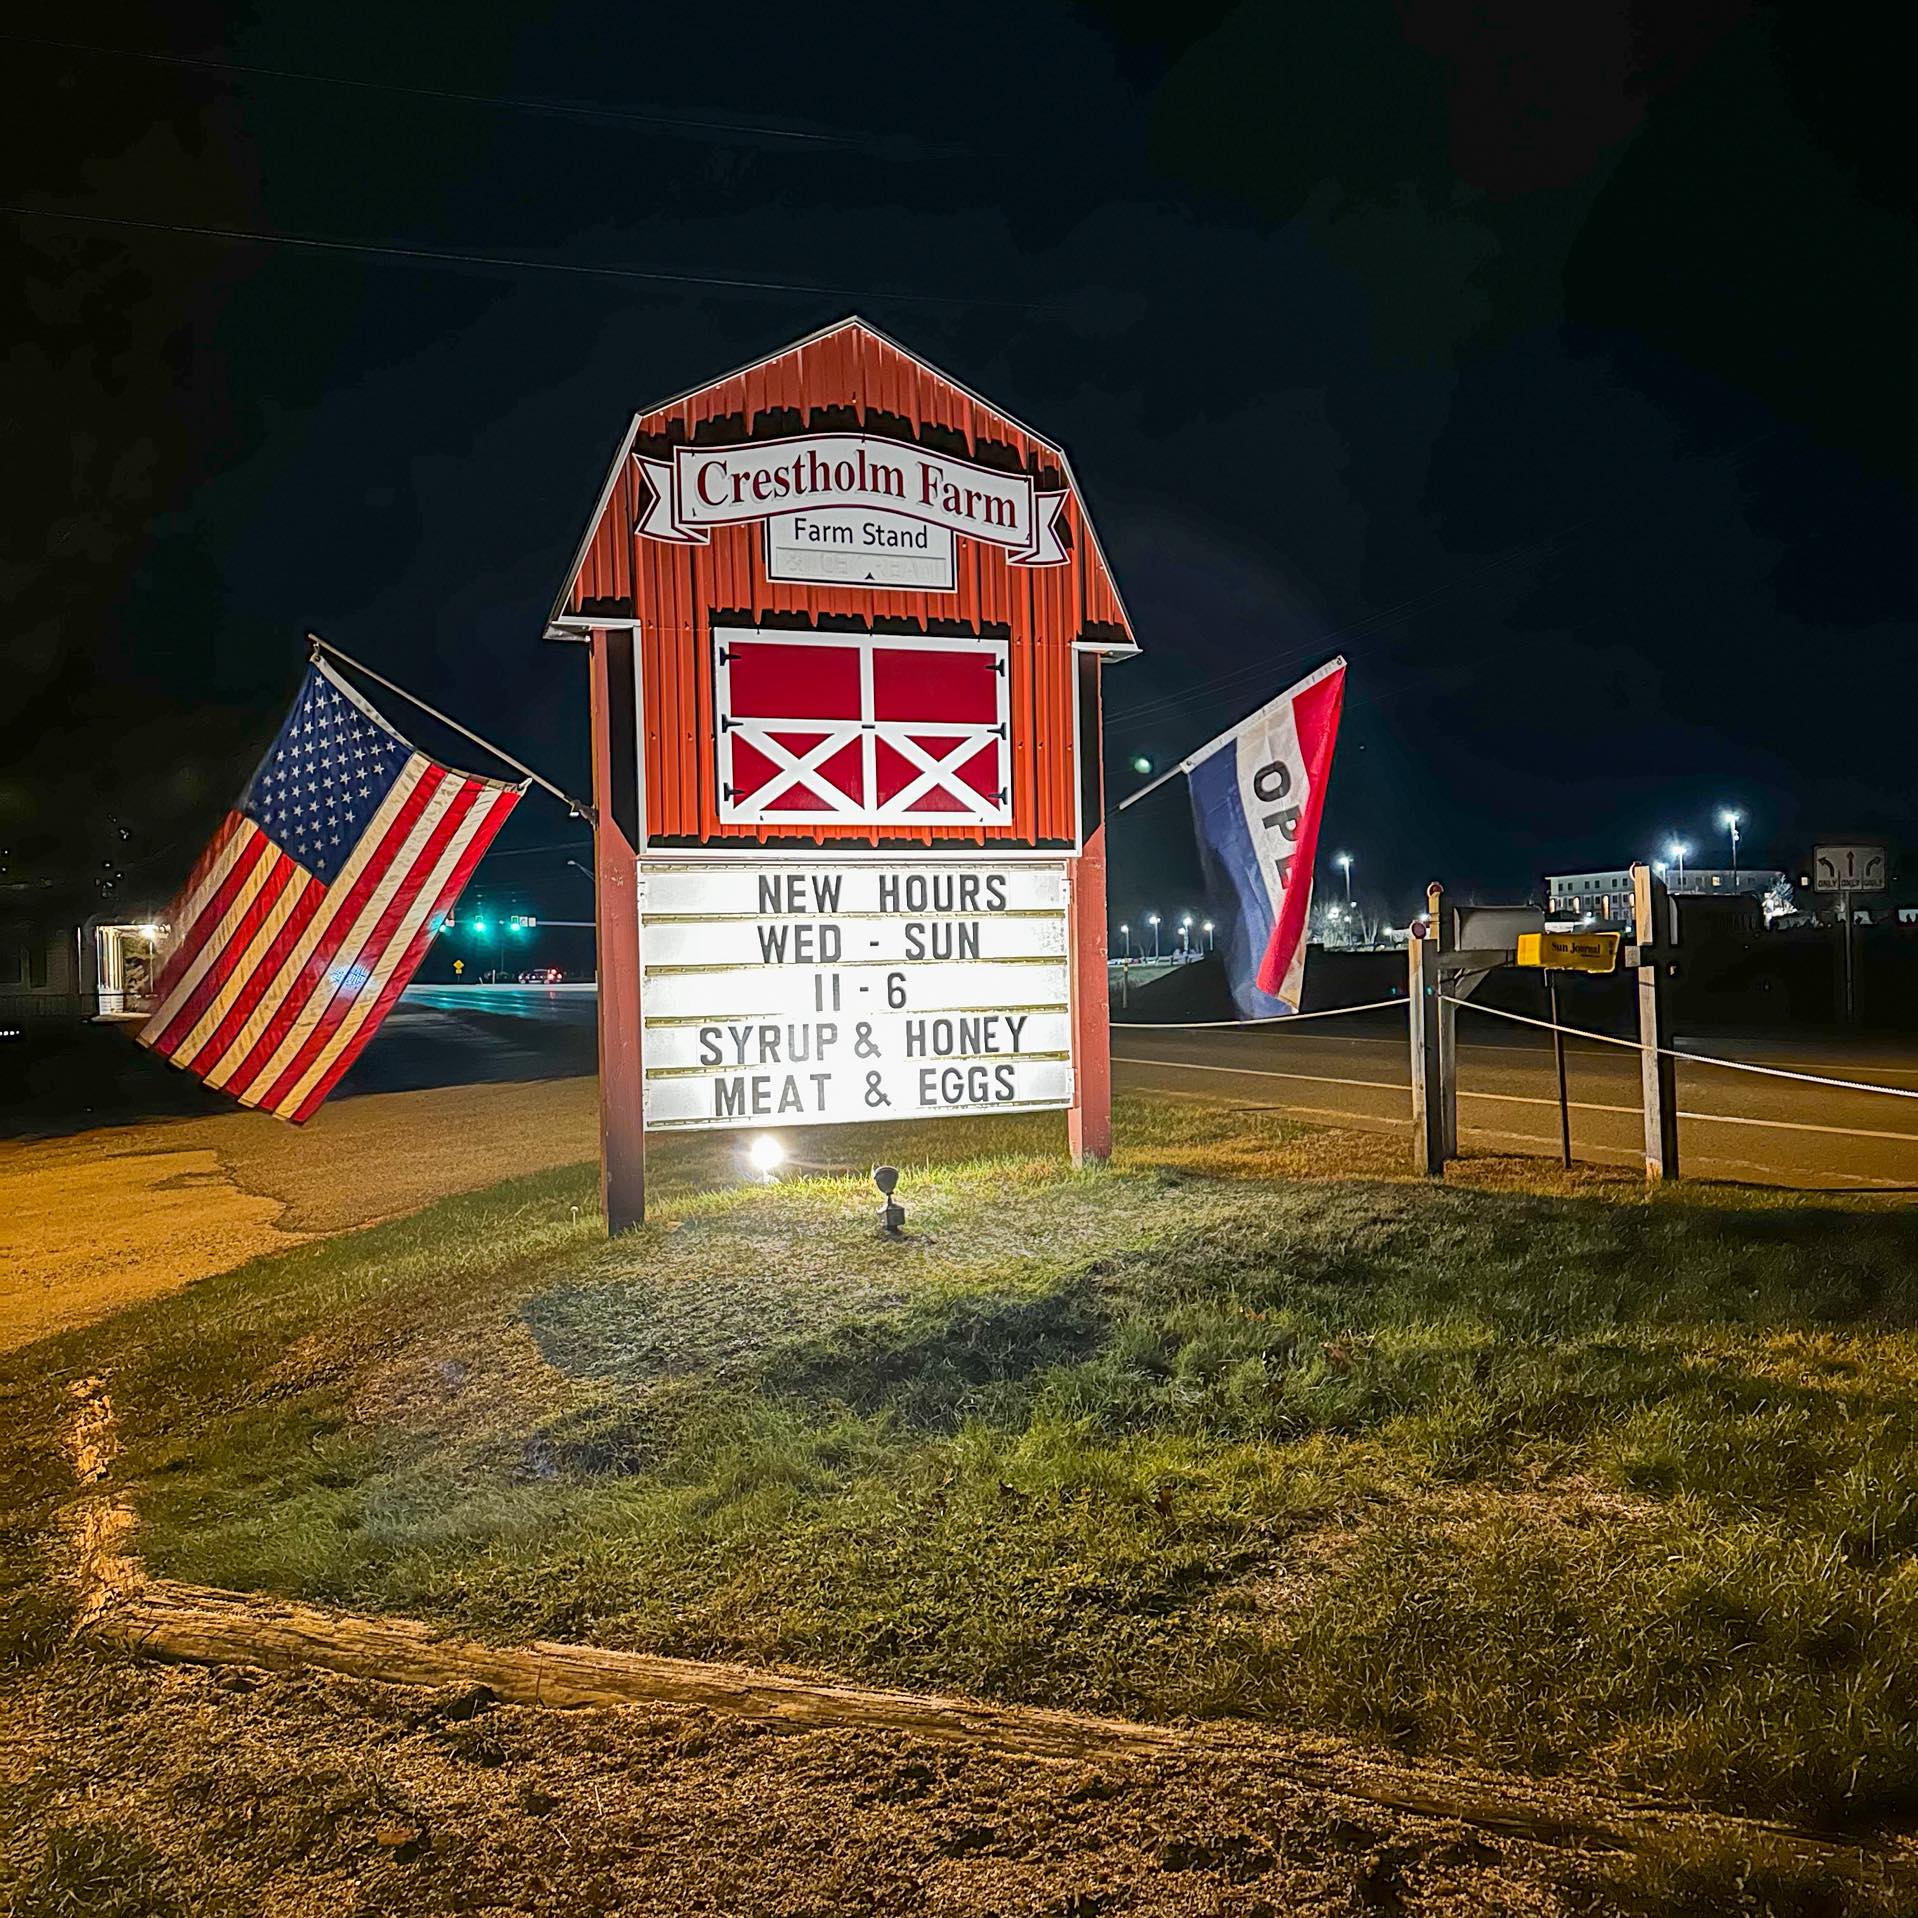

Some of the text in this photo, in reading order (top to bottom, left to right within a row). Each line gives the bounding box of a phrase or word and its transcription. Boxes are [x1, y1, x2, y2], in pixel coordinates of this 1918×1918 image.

[697, 449, 1018, 529] Crestholm Farm
[794, 517, 928, 549] Farm Stand
[1254, 760, 1302, 889] OPE
[758, 874, 1006, 913] NEW HOURS
[1818, 879, 1837, 888] ONLY
[757, 924, 842, 963] WED
[905, 922, 980, 961] SUN
[1551, 942, 1600, 954] Sun Journal
[887, 972, 907, 1009] 6
[700, 1015, 1028, 1066] SYRUP & HONEY
[714, 1064, 1015, 1117] MEAT & EGGS
